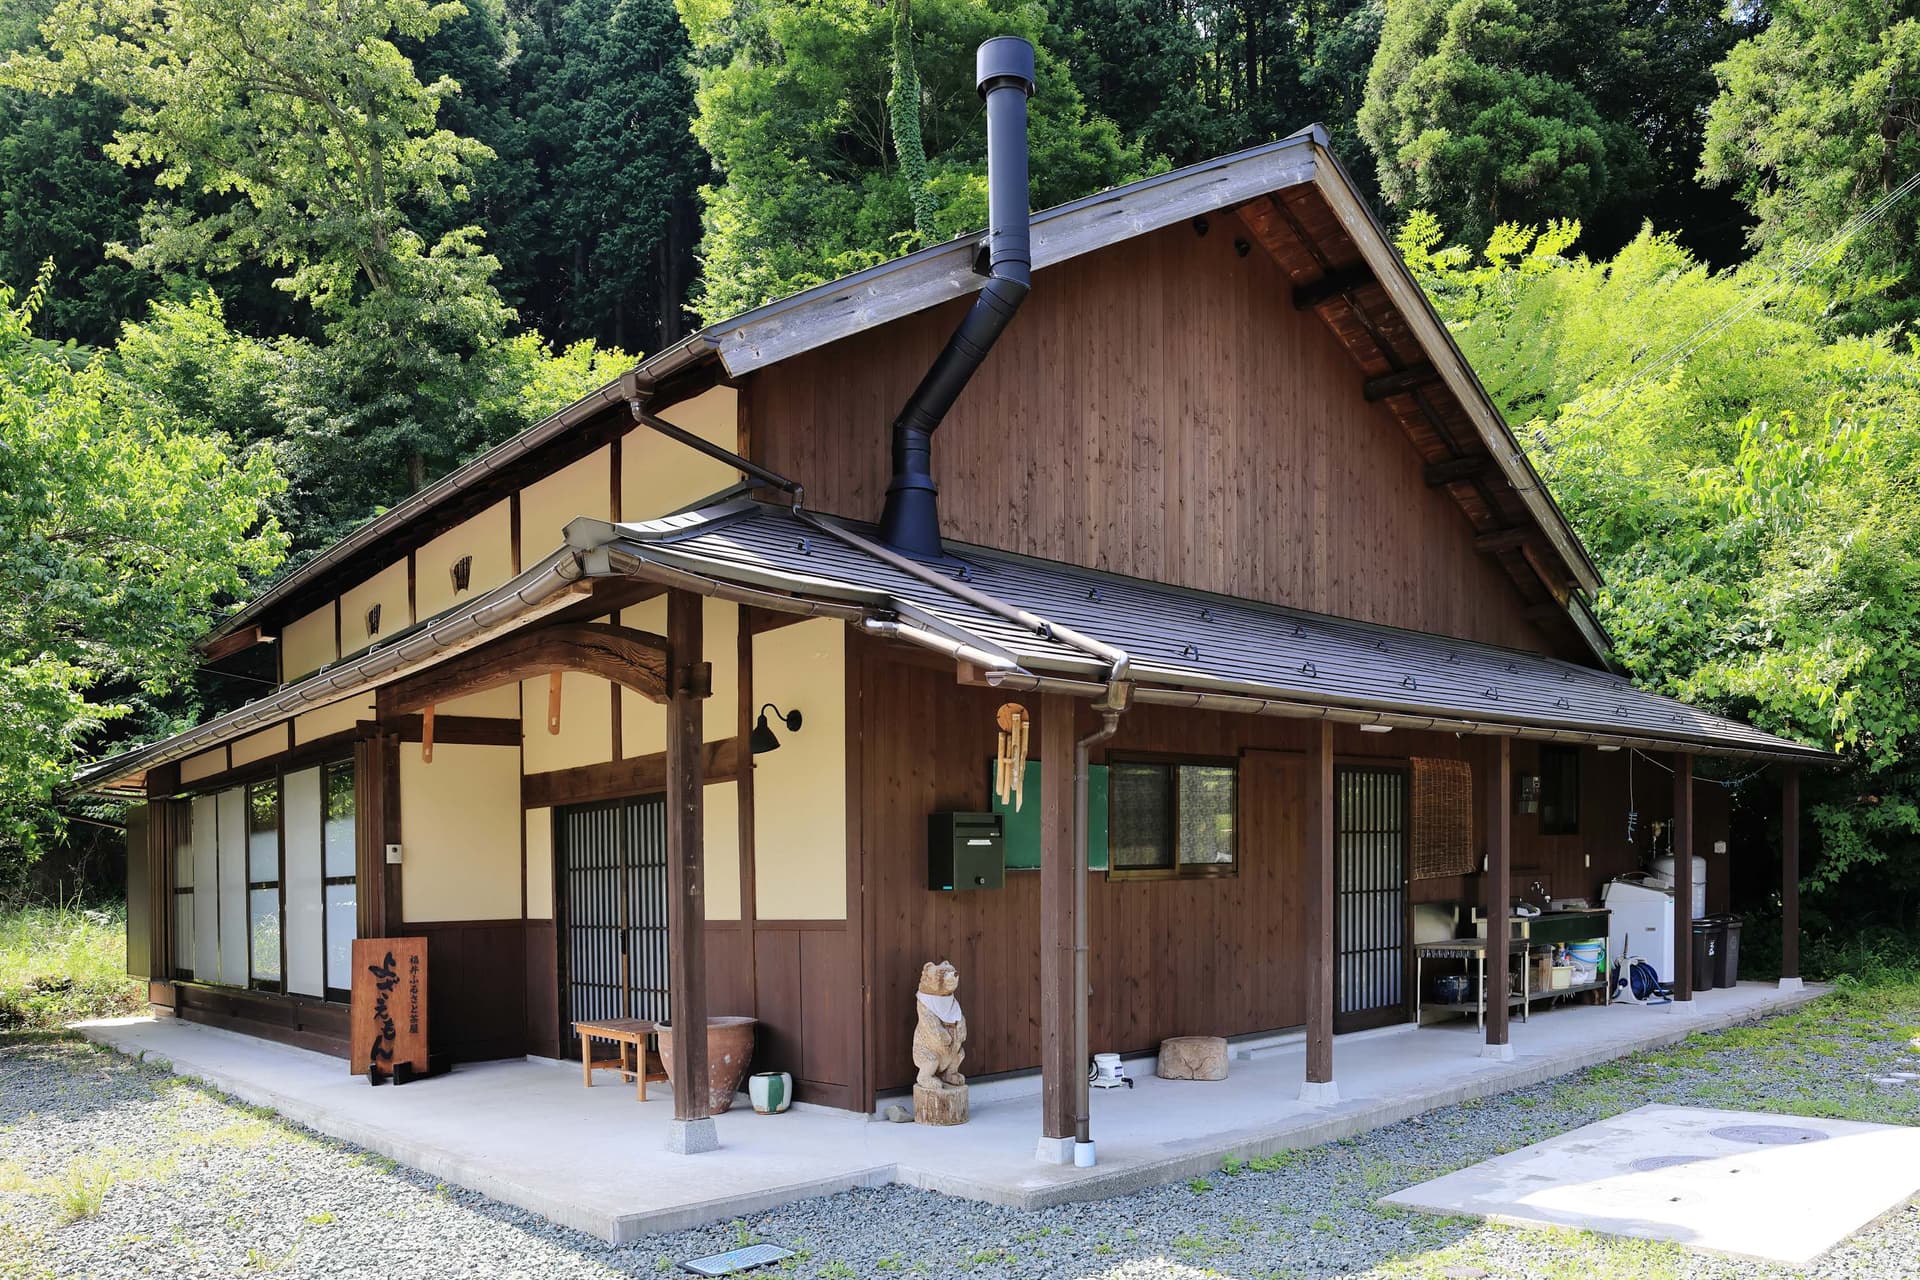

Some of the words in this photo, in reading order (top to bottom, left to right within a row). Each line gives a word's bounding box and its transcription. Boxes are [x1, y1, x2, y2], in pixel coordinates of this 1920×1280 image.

[409, 955, 420, 1033] 福井ふるさと茶屋
